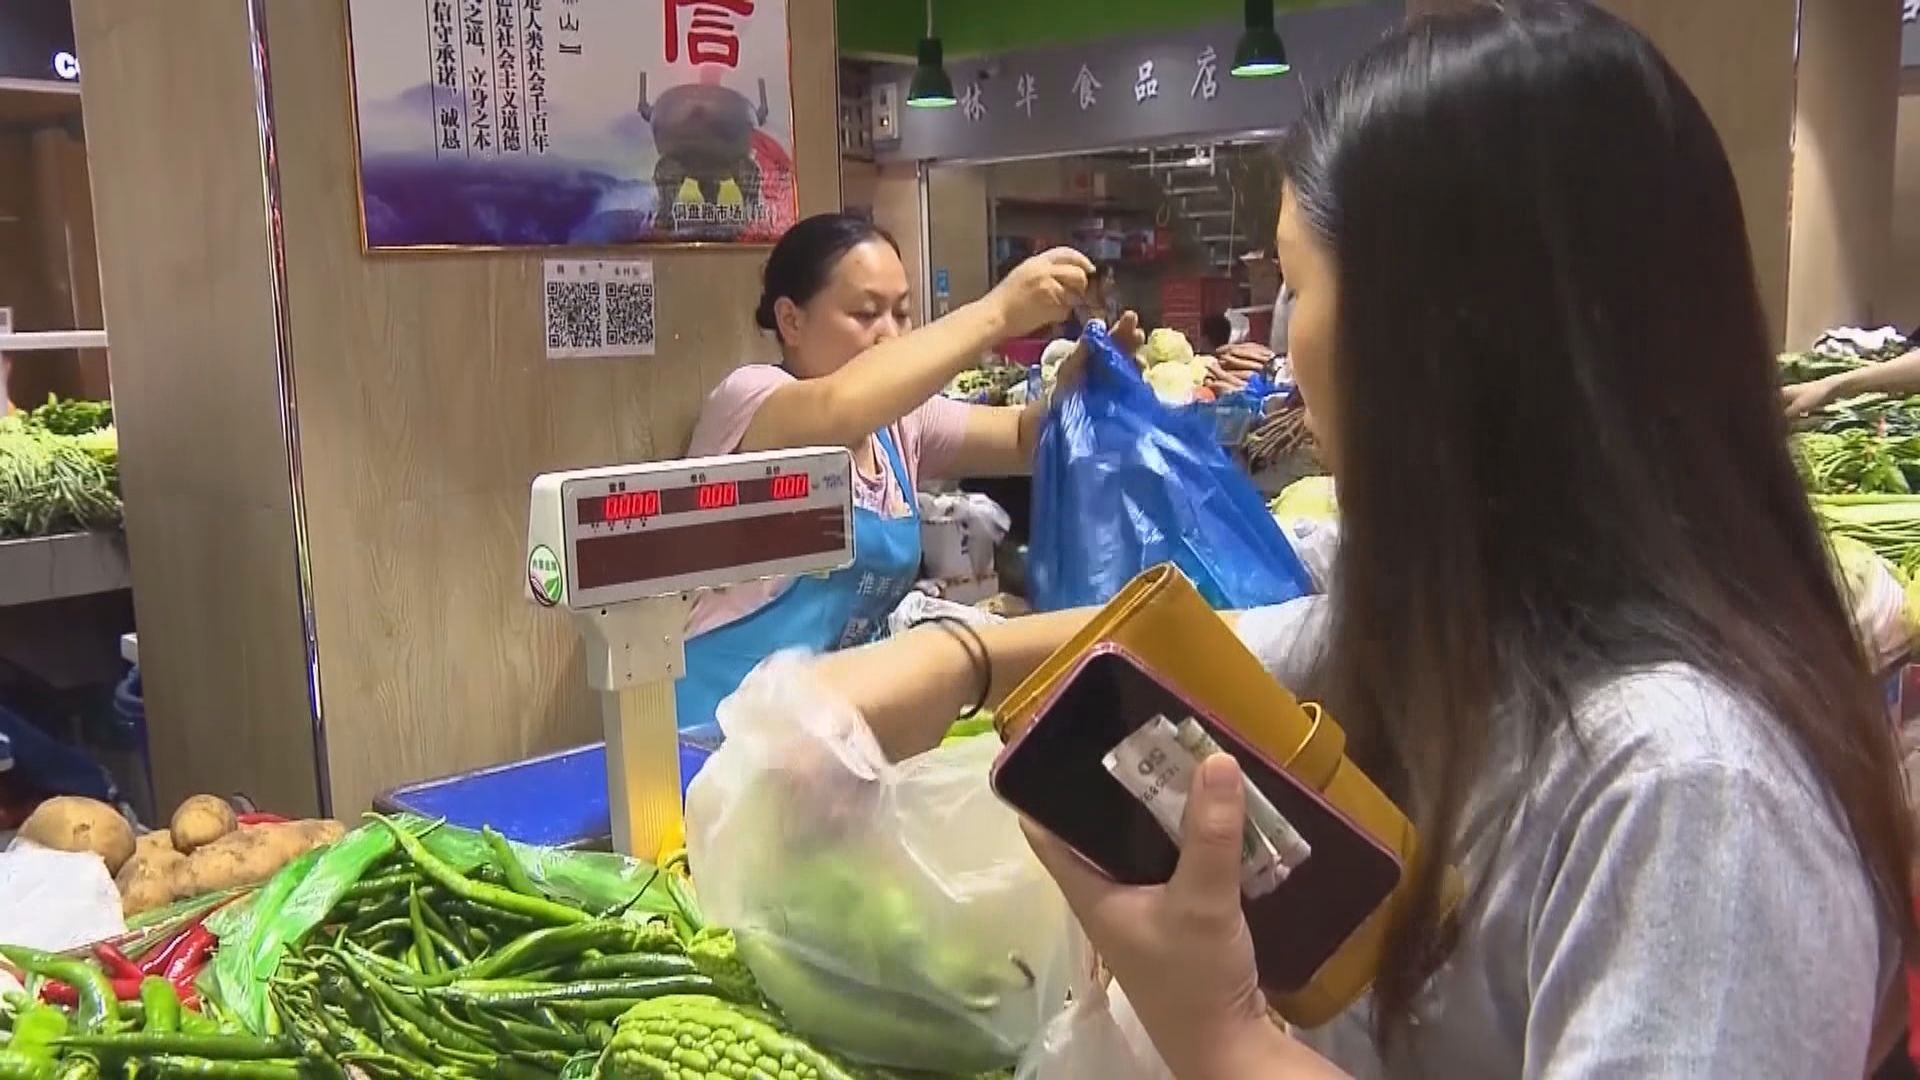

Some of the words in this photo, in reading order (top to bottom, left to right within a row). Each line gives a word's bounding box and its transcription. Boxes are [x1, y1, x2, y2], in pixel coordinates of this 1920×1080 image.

[960, 46, 1218, 121] 林华食品店
